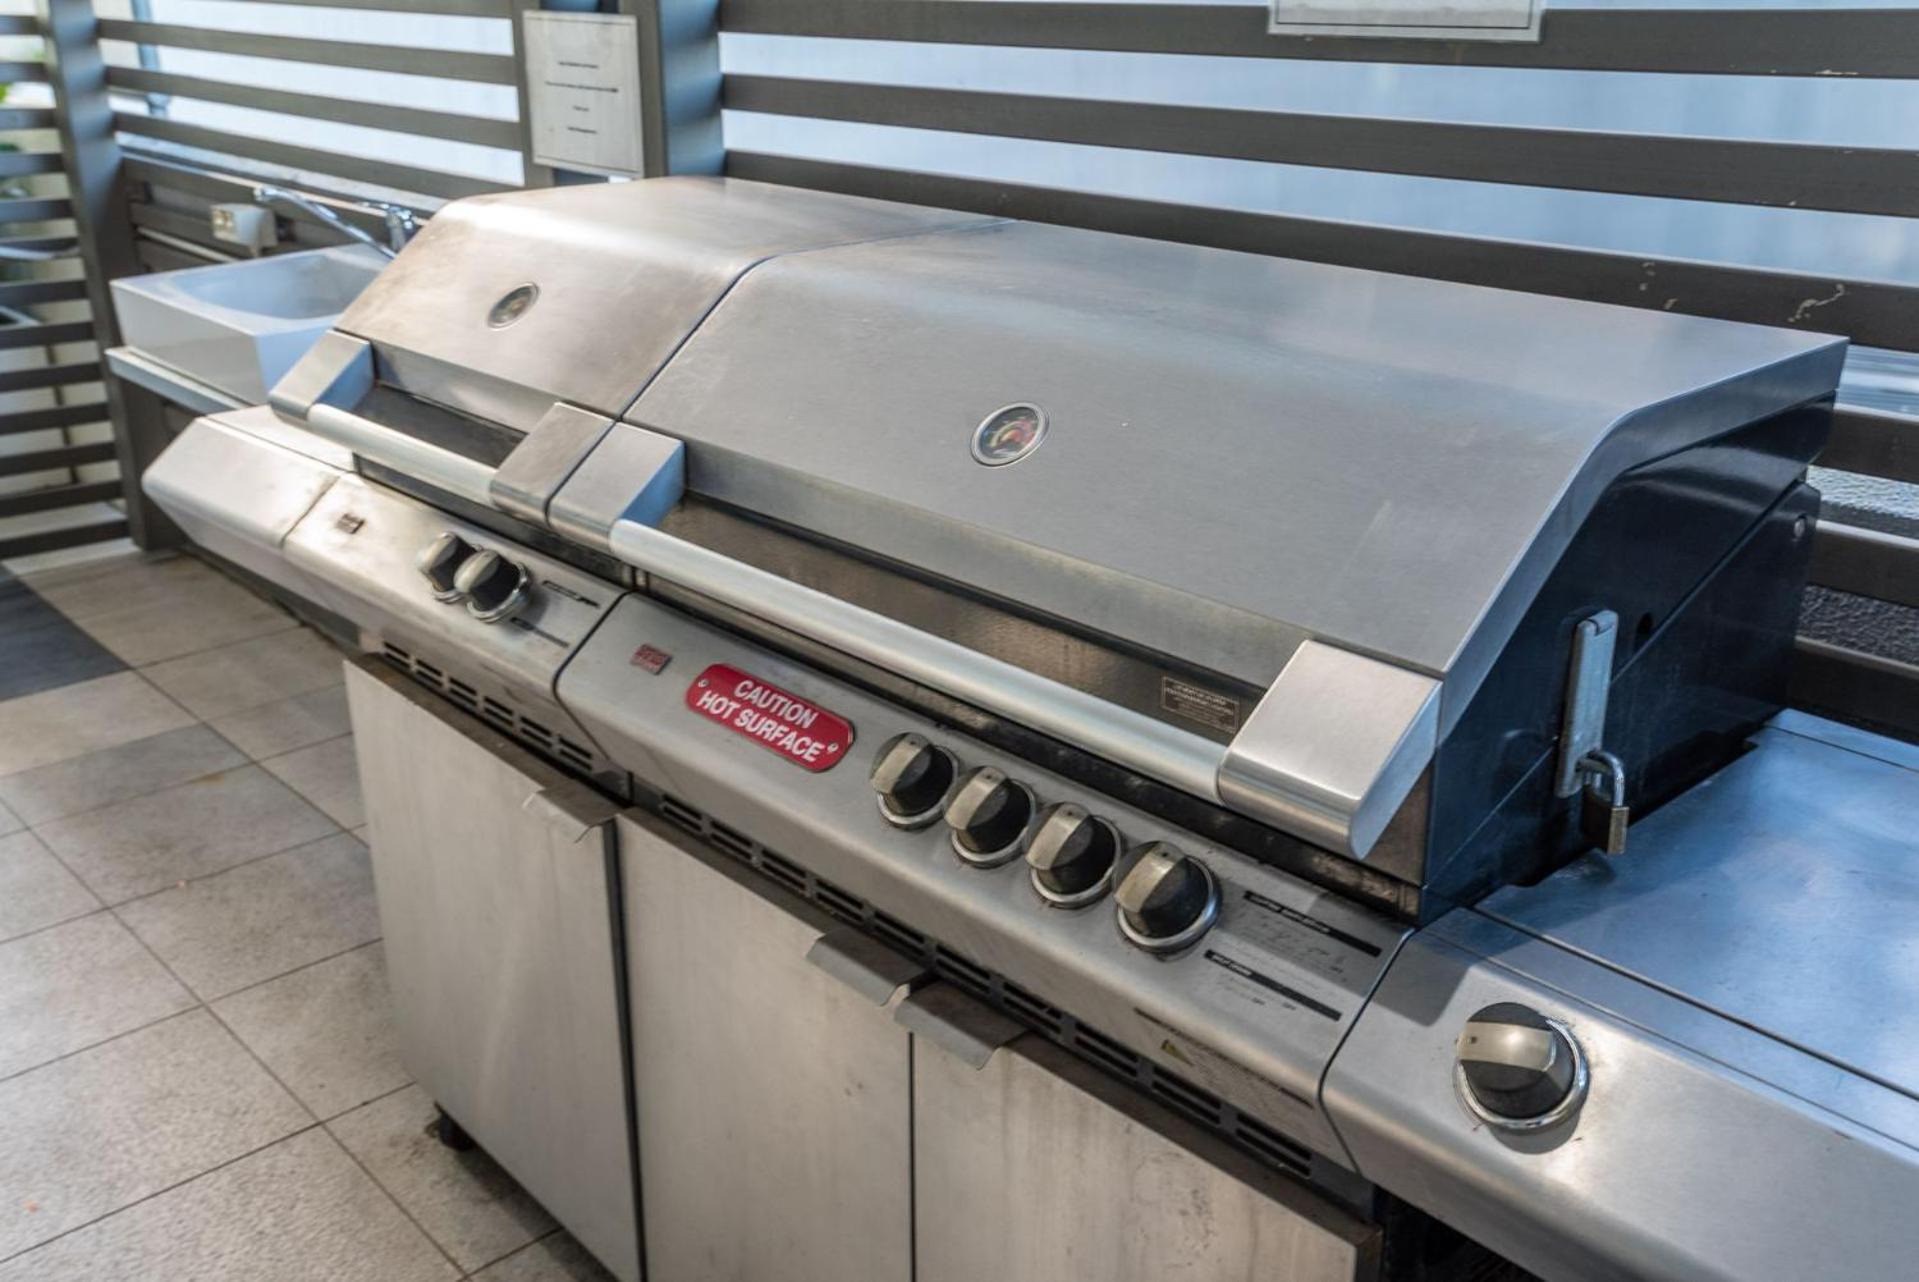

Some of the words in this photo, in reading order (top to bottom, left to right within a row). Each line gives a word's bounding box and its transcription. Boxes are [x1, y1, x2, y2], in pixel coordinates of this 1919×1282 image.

[696, 690, 741, 719] HOT
[734, 708, 825, 762] SURFACE
[734, 680, 818, 729] CAUTION
